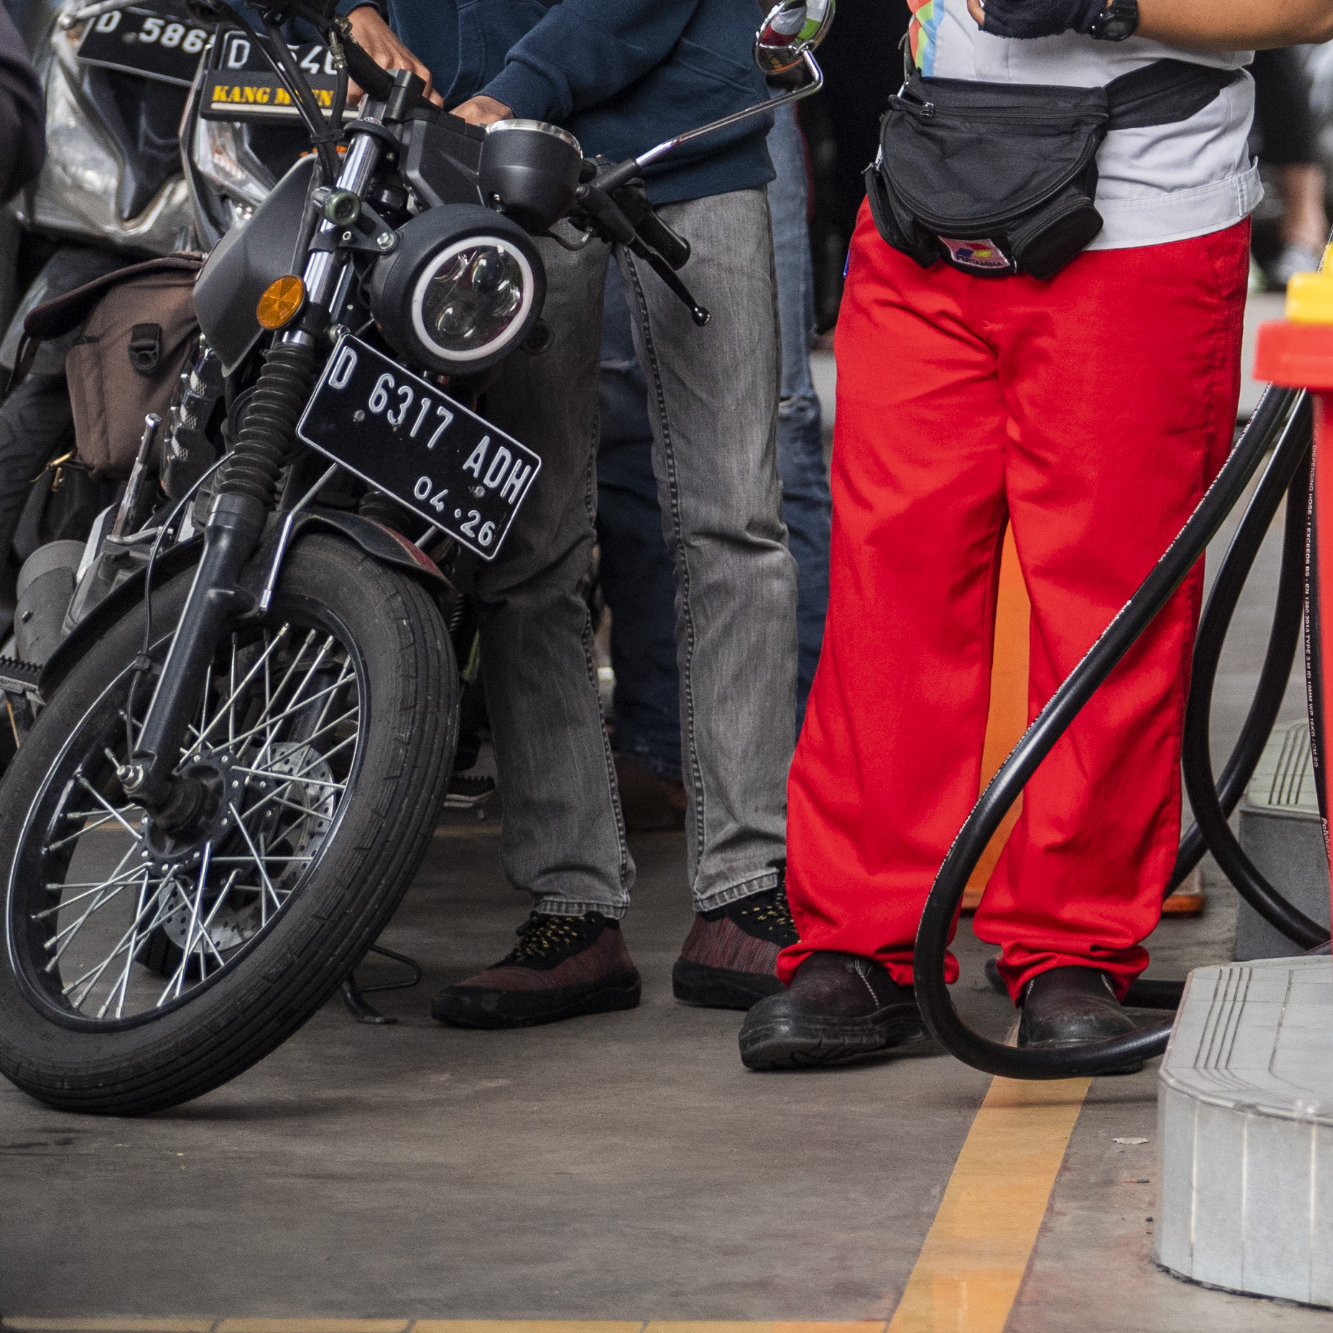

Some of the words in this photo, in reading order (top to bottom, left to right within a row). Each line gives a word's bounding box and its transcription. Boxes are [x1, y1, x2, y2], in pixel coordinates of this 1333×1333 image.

[94, 10, 122, 34] D
[138, 17, 216, 54] 586
[227, 38, 251, 68] D
[211, 84, 271, 103] KANG
[955, 254, 1004, 267] PERTAMINA
[328, 345, 358, 390] D
[368, 372, 454, 449] 6317
[462, 435, 532, 505] ADH
[1309, 444, 1317, 492] DISPENSING
[1304, 583, 1309, 594] EN
